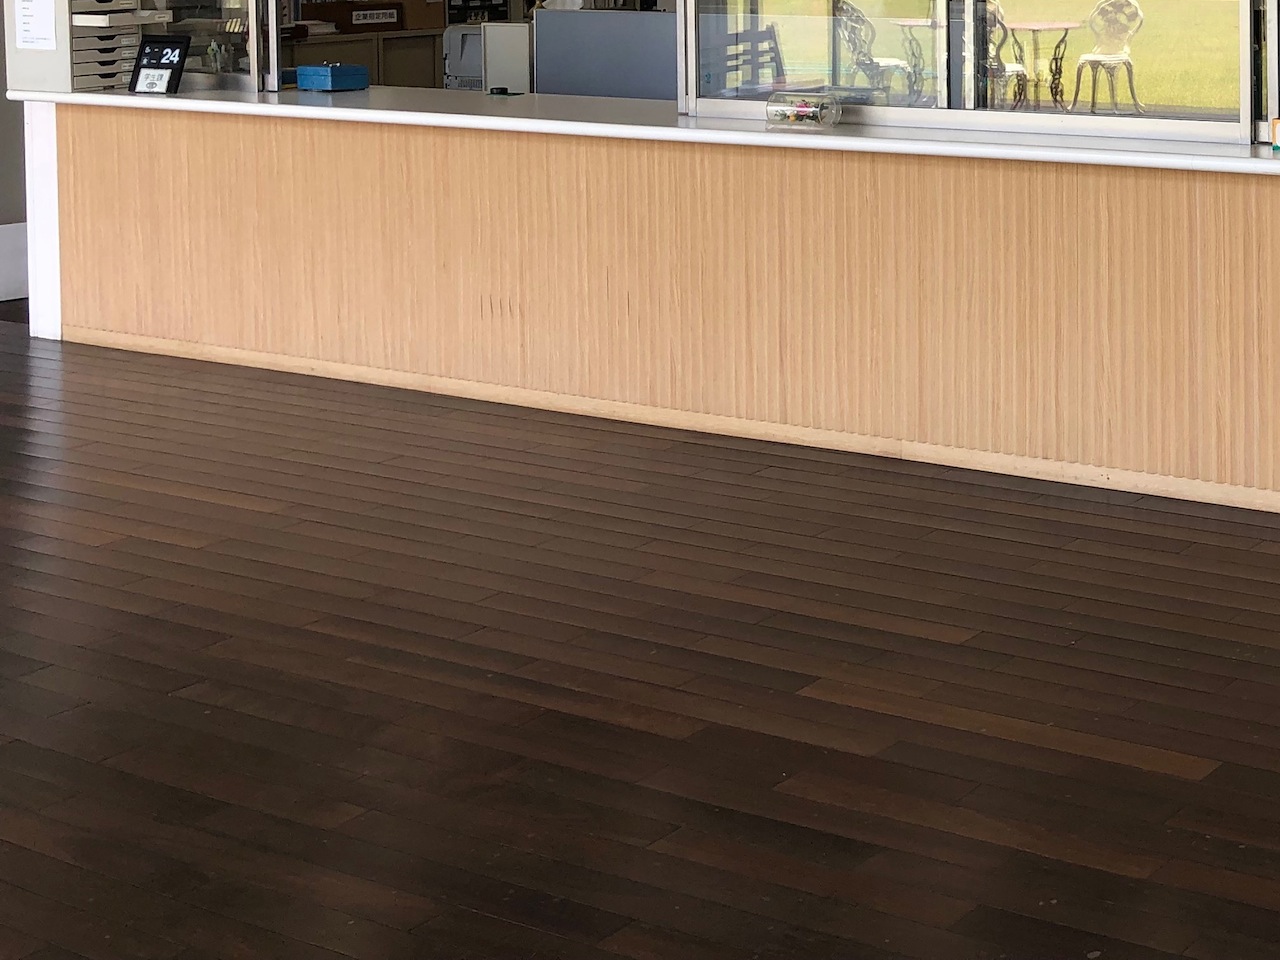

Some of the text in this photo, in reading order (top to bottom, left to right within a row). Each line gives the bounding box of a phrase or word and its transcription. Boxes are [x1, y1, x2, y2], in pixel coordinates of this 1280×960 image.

[354, 11, 396, 21] 企業指定用紙
[160, 47, 181, 64] 24
